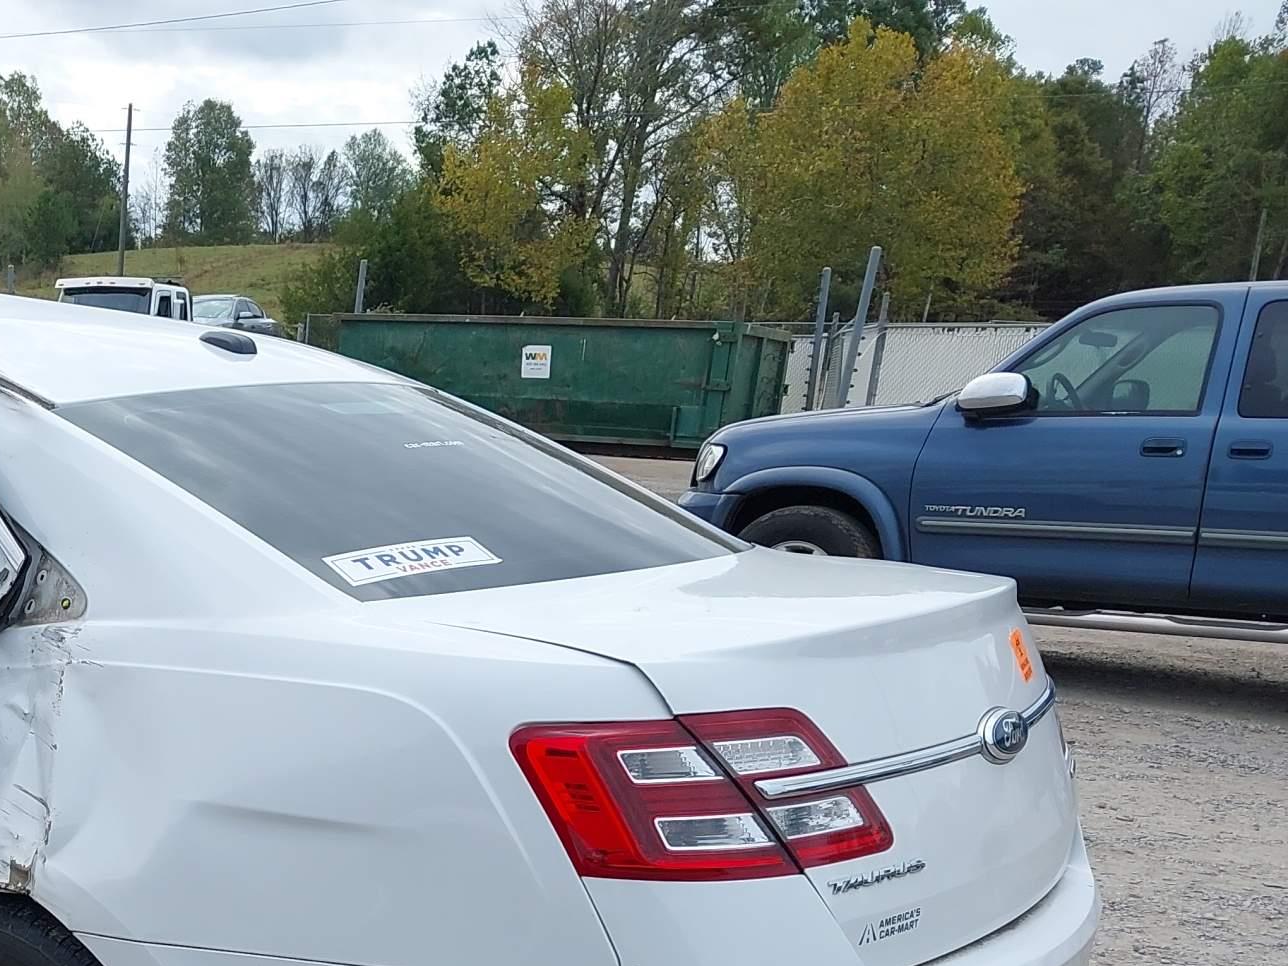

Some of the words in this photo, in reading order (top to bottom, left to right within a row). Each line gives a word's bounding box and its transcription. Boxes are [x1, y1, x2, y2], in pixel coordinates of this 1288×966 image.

[525, 352, 547, 361] WM
[924, 504, 954, 512] TOYOTA
[952, 505, 1026, 518] TUNDRA
[352, 544, 465, 571] TRUMP
[396, 559, 453, 573] VANCE
[827, 860, 927, 895] TAURUS
[878, 907, 921, 929] AMERICA'S
[878, 919, 919, 940] CAR-MART
